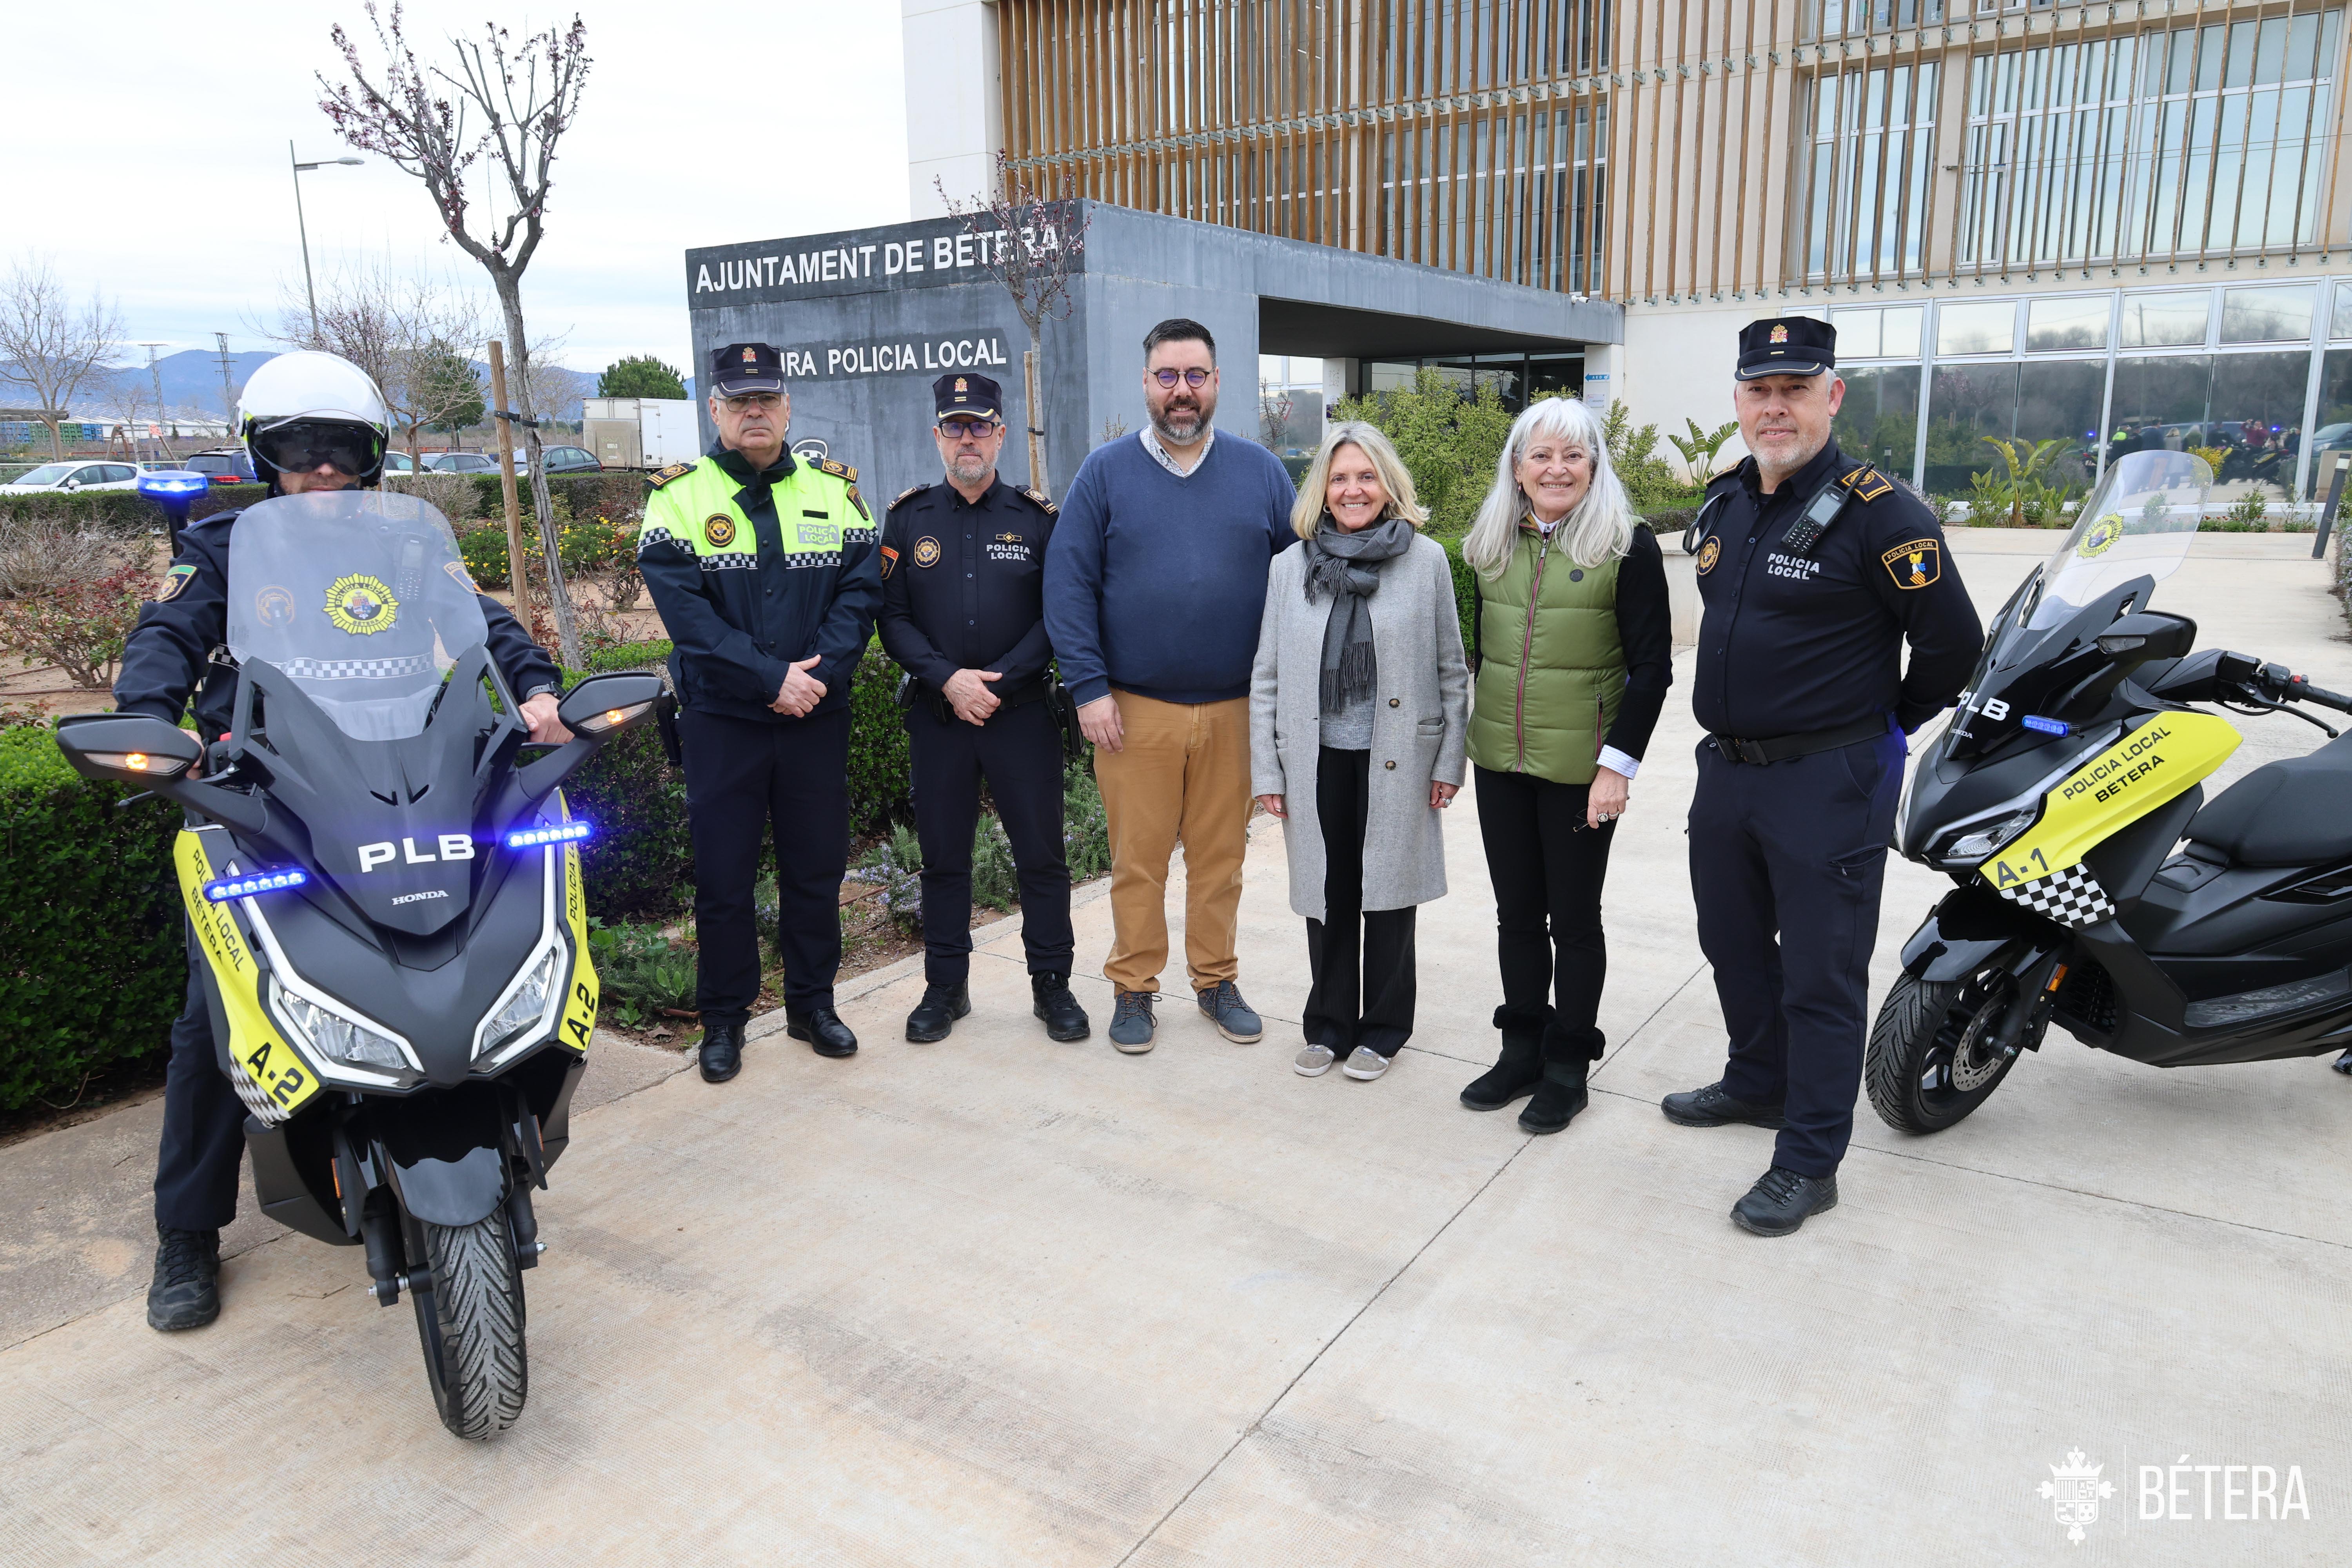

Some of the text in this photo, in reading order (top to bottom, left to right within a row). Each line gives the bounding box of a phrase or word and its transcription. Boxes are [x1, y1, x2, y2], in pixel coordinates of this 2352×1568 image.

[695, 245, 876, 293] AJUNTAMENT
[885, 239, 924, 275] DE
[828, 343, 918, 375] POLICIA
[924, 338, 1007, 369] LOCAL
[799, 525, 837, 535] POLICIA
[804, 534, 835, 543] LOCAL
[986, 544, 1030, 554] POLICIA
[991, 552, 1026, 561] LOCAL
[1887, 545, 1912, 560] POLICIA
[1767, 553, 1820, 573] POLICIA
[1767, 564, 1810, 580] LOCAL
[335, 584, 386, 605] POLICIA LOCAL
[1956, 691, 2010, 721] PLB
[2062, 727, 2172, 800] POLICIA LOCAL
[2094, 755, 2165, 803] BÉTERA
[358, 834, 475, 873] PLB
[392, 890, 449, 905] HONDA
[216, 913, 244, 972] LOCAL
